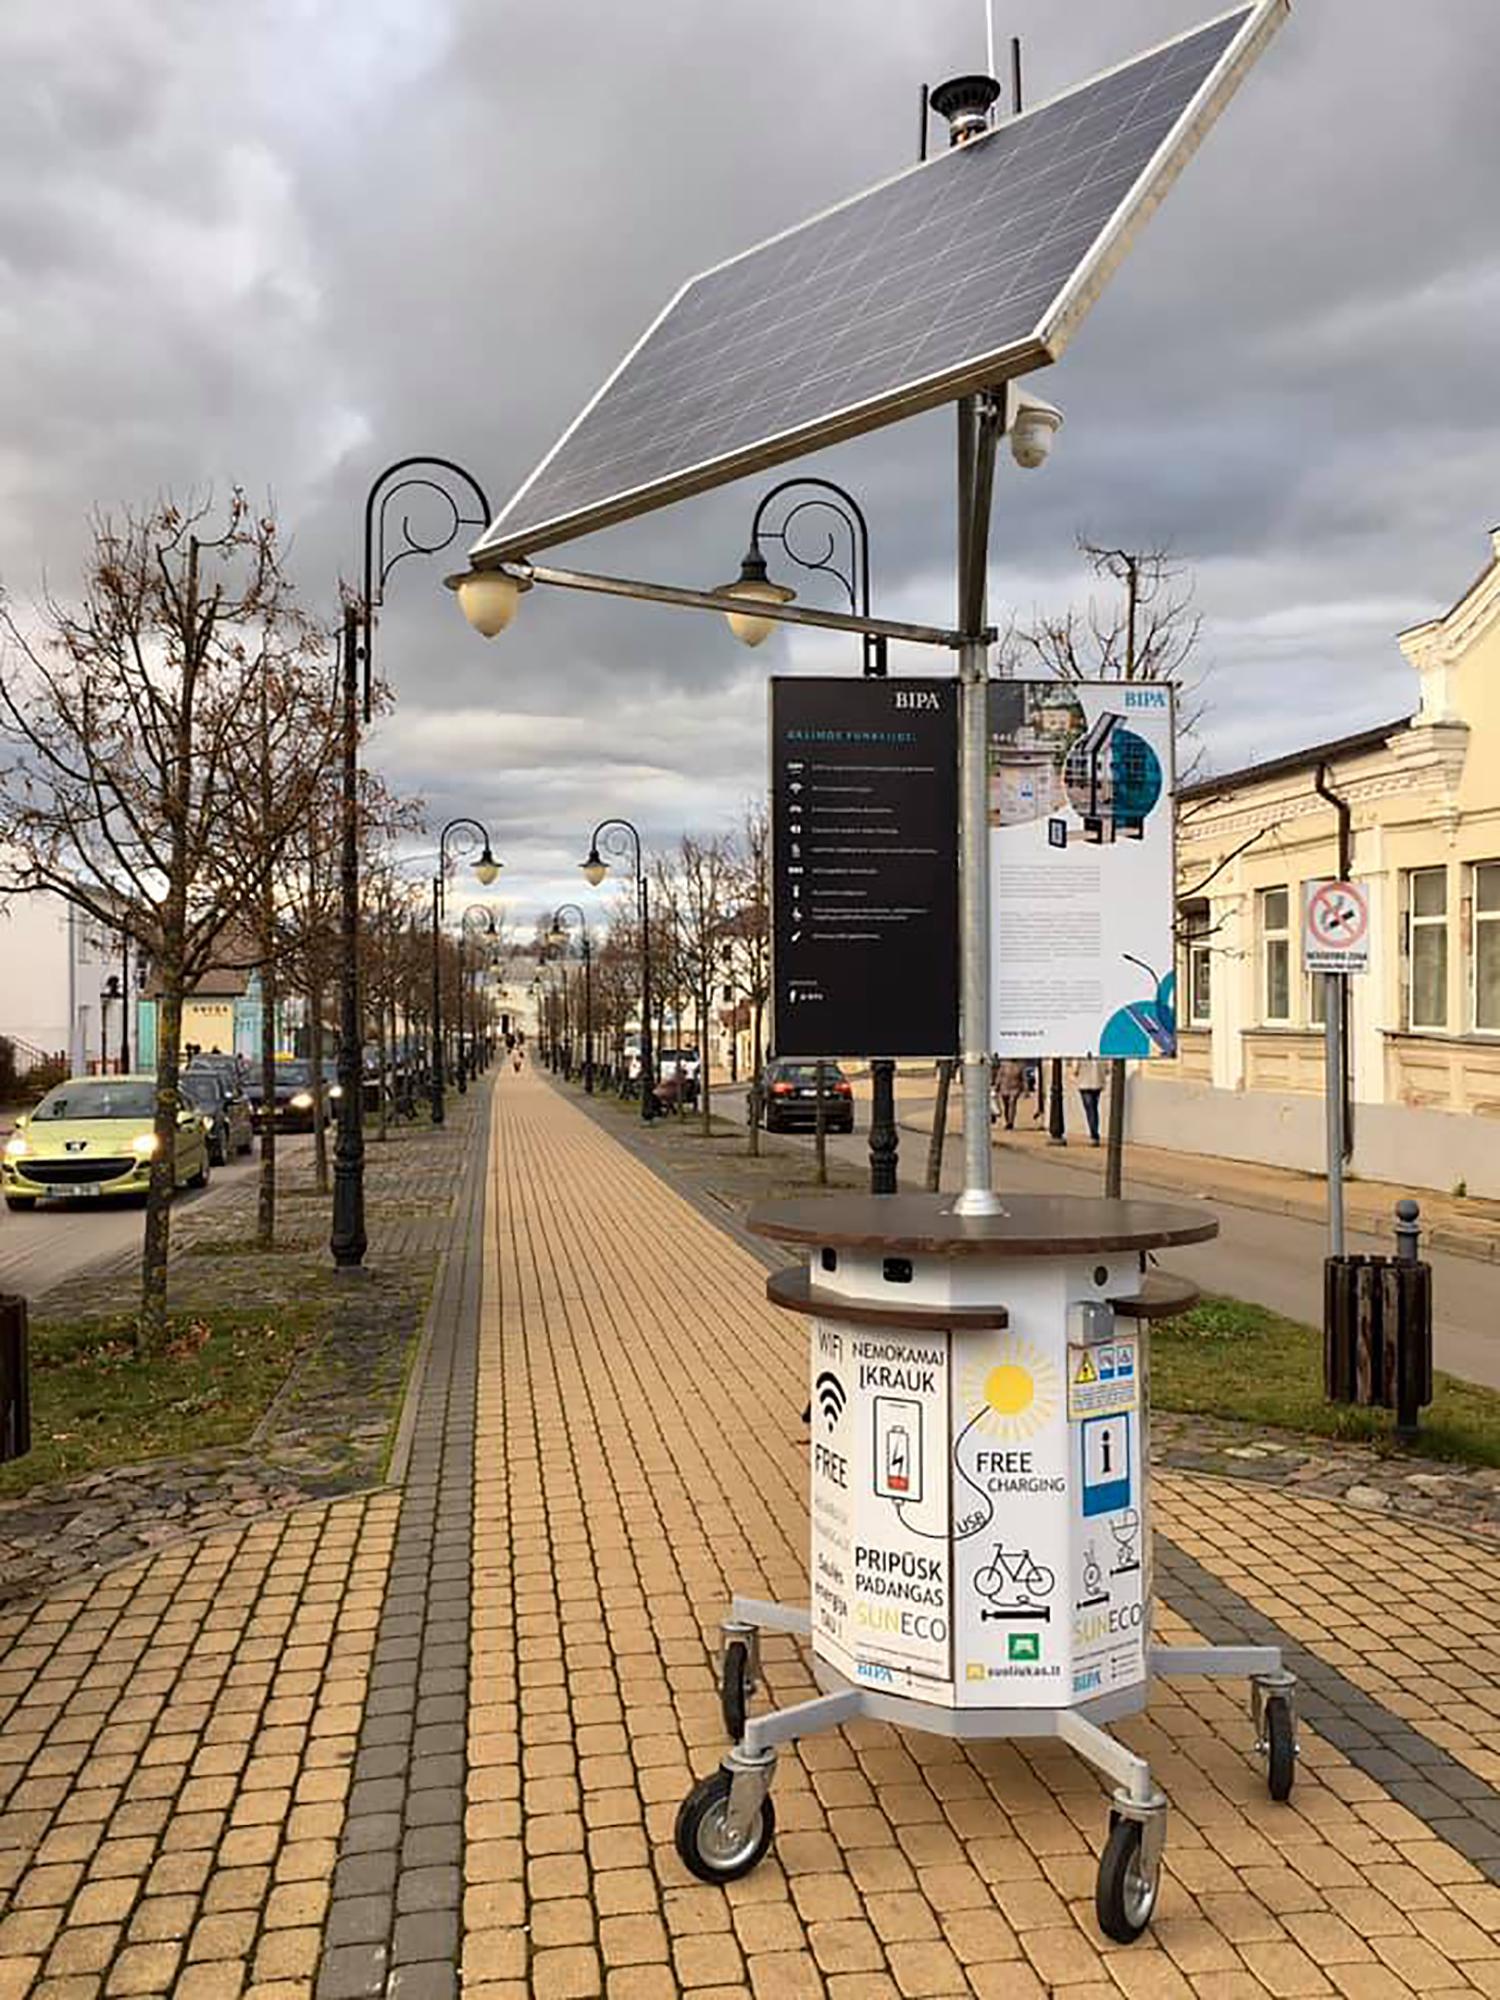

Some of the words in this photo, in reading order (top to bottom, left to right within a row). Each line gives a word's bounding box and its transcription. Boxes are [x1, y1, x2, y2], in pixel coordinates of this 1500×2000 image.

[895, 691, 940, 710] BIPA
[1124, 690, 1166, 709] BIPA
[852, 1341, 945, 1368] NEMOKAMAI
[859, 1364, 937, 1394] ĮKRAUK
[815, 1443, 849, 1490] FREE
[977, 1451, 1033, 1474] FREE
[986, 1477, 1066, 1494] CHARGING
[956, 1509, 988, 1535] USB
[855, 1546, 943, 1584] PRIPŪSK
[855, 1572, 944, 1607] PADANGAS
[855, 1600, 948, 1643] SUNECO
[1072, 1602, 1142, 1646] SUNECO
[856, 1662, 894, 1684] BIPA
